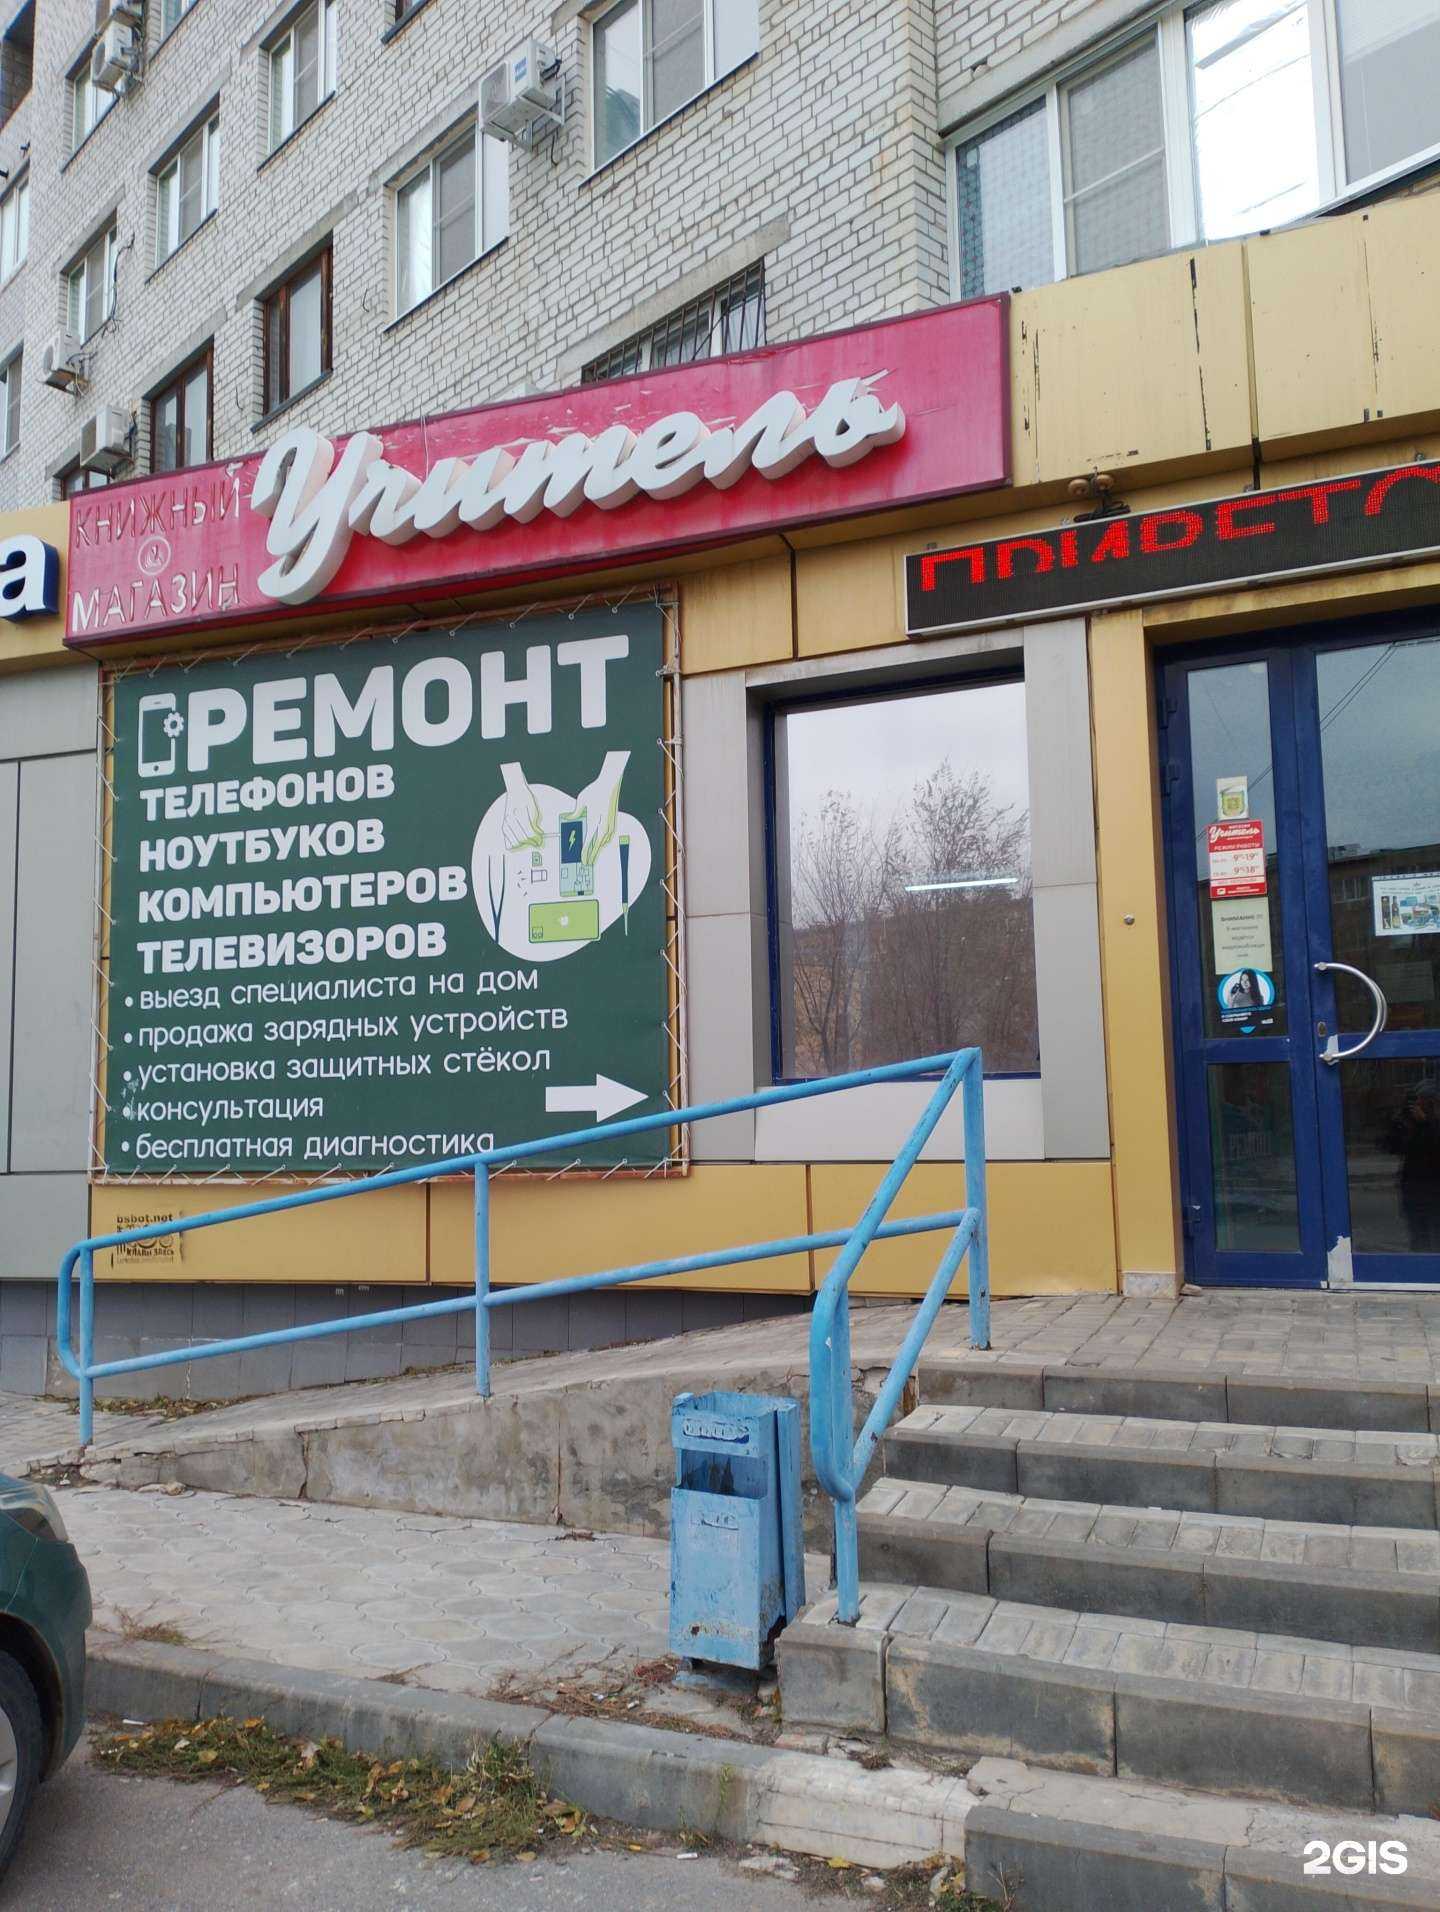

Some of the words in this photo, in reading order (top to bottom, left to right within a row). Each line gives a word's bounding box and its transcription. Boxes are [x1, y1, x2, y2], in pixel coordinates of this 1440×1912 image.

[76, 464, 241, 548] КНИЖНЫЙ
[251, 377, 905, 604] Учитель
[72, 563, 241, 632] МАГАЗИН
[187, 634, 630, 773] РЕМОНТ
[139, 763, 396, 822] ТЕЛЕФОНОВ
[139, 818, 386, 873] НОУТБУКОВ
[138, 865, 468, 924] КОМПЬЮТЕРОВ
[136, 922, 447, 975] ТЕЛЕВИЗОРОВ
[140, 986, 221, 1010] выезд
[230, 975, 416, 1005] специалиста
[429, 973, 464, 995] на
[476, 969, 538, 996] дом
[138, 1021, 253, 1053] продажа
[263, 1014, 400, 1047] зарядных
[410, 1004, 568, 1042] устройств
[137, 1059, 276, 1091] установка
[286, 1053, 432, 1081] защитных
[443, 1046, 551, 1074] стёкол
[137, 1097, 324, 1127] консультация
[136, 1132, 293, 1159] бесплатная
[303, 1132, 494, 1160] диагностика
